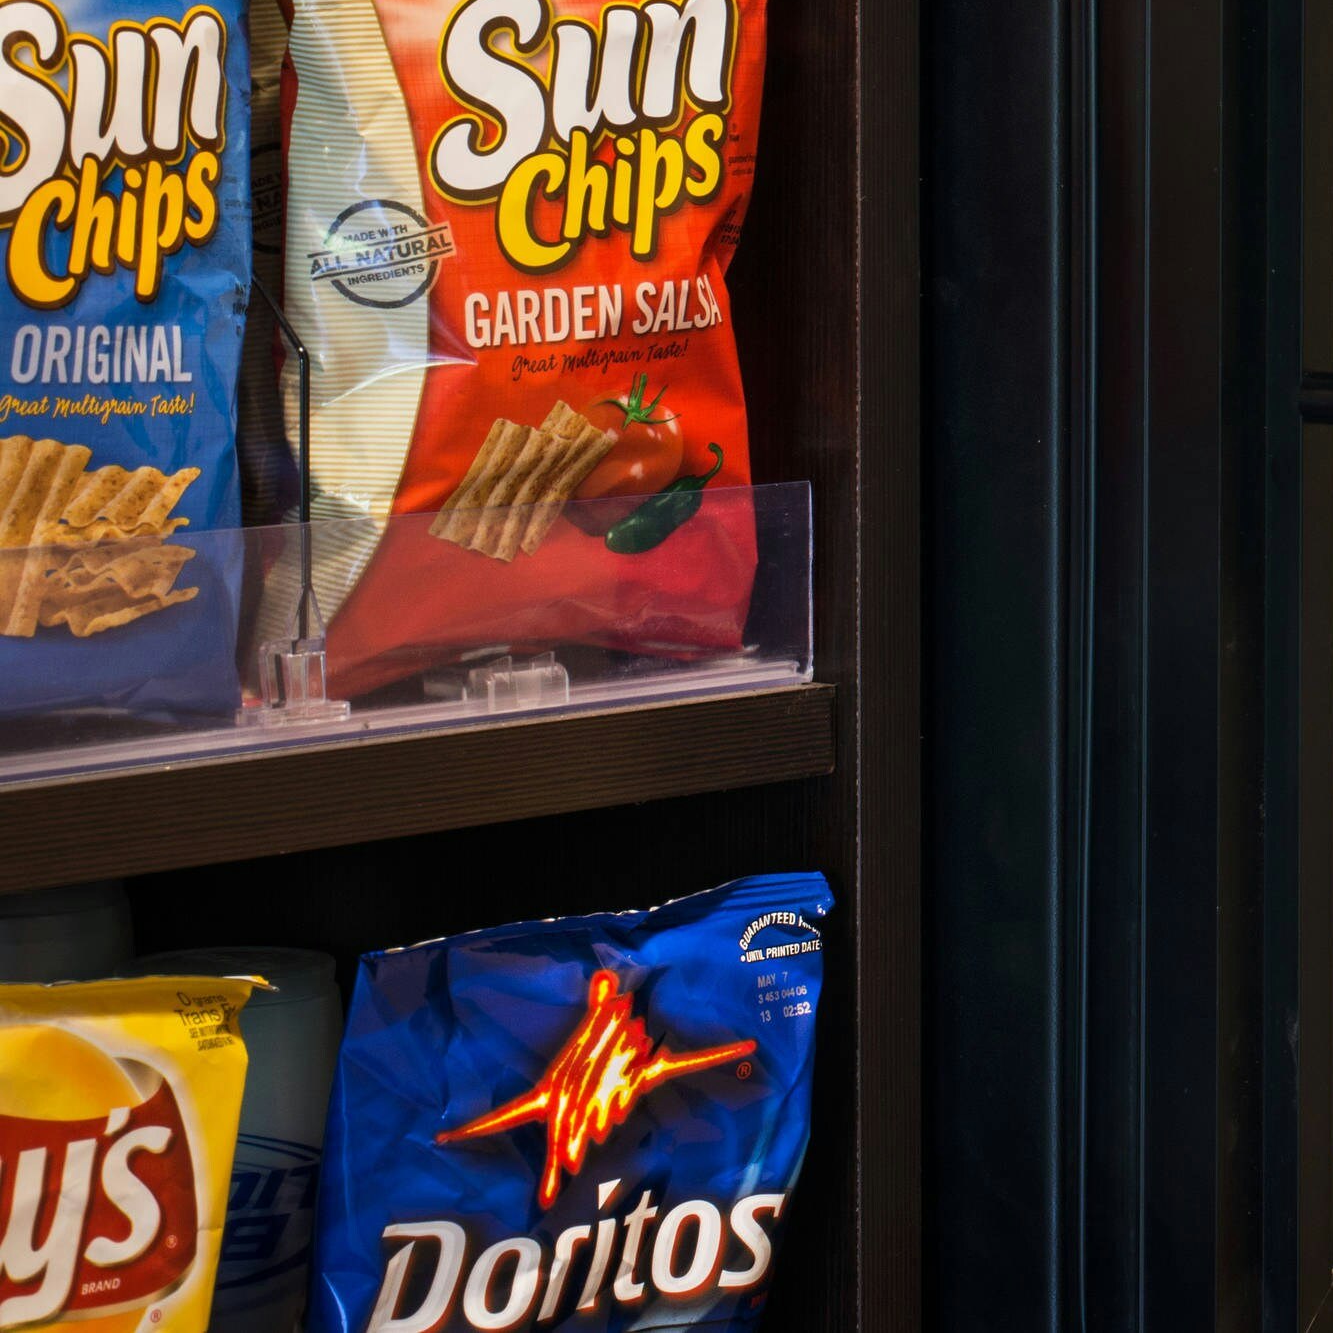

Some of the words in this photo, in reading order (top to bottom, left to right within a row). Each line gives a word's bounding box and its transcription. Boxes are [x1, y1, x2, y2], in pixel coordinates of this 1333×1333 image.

[0, 0, 222, 216] Sun
[498, 113, 724, 268] Chips
[7, 150, 220, 305] Chips
[310, 257, 349, 276] ALL
[355, 232, 453, 266] NATURAL
[347, 263, 426, 286] INGREDIENTS
[464, 283, 623, 349] GARDEN
[632, 273, 723, 335] SALSA
[10, 323, 193, 384] ORIGINAL
[511, 353, 557, 382] Great
[561, 347, 643, 375] Multigrain
[646, 338, 689, 363] Taste!
[0, 393, 49, 424] Great
[52, 393, 148, 426] Multigrain
[150, 391, 196, 417] Taste!
[739, 912, 796, 951] GUARANTEED
[746, 949, 766, 963] UNTIL
[765, 943, 800, 959] PRINTED
[801, 938, 821, 954] DATE
[757, 972, 777, 989] MAY
[782, 971, 789, 983] 7
[173, 1008, 222, 1027] Trans
[760, 1009, 772, 1023] 13
[783, 1001, 812, 1018] 02:52
[364, 1177, 786, 1333] Doritos
[81, 1277, 121, 1296] BRAND
